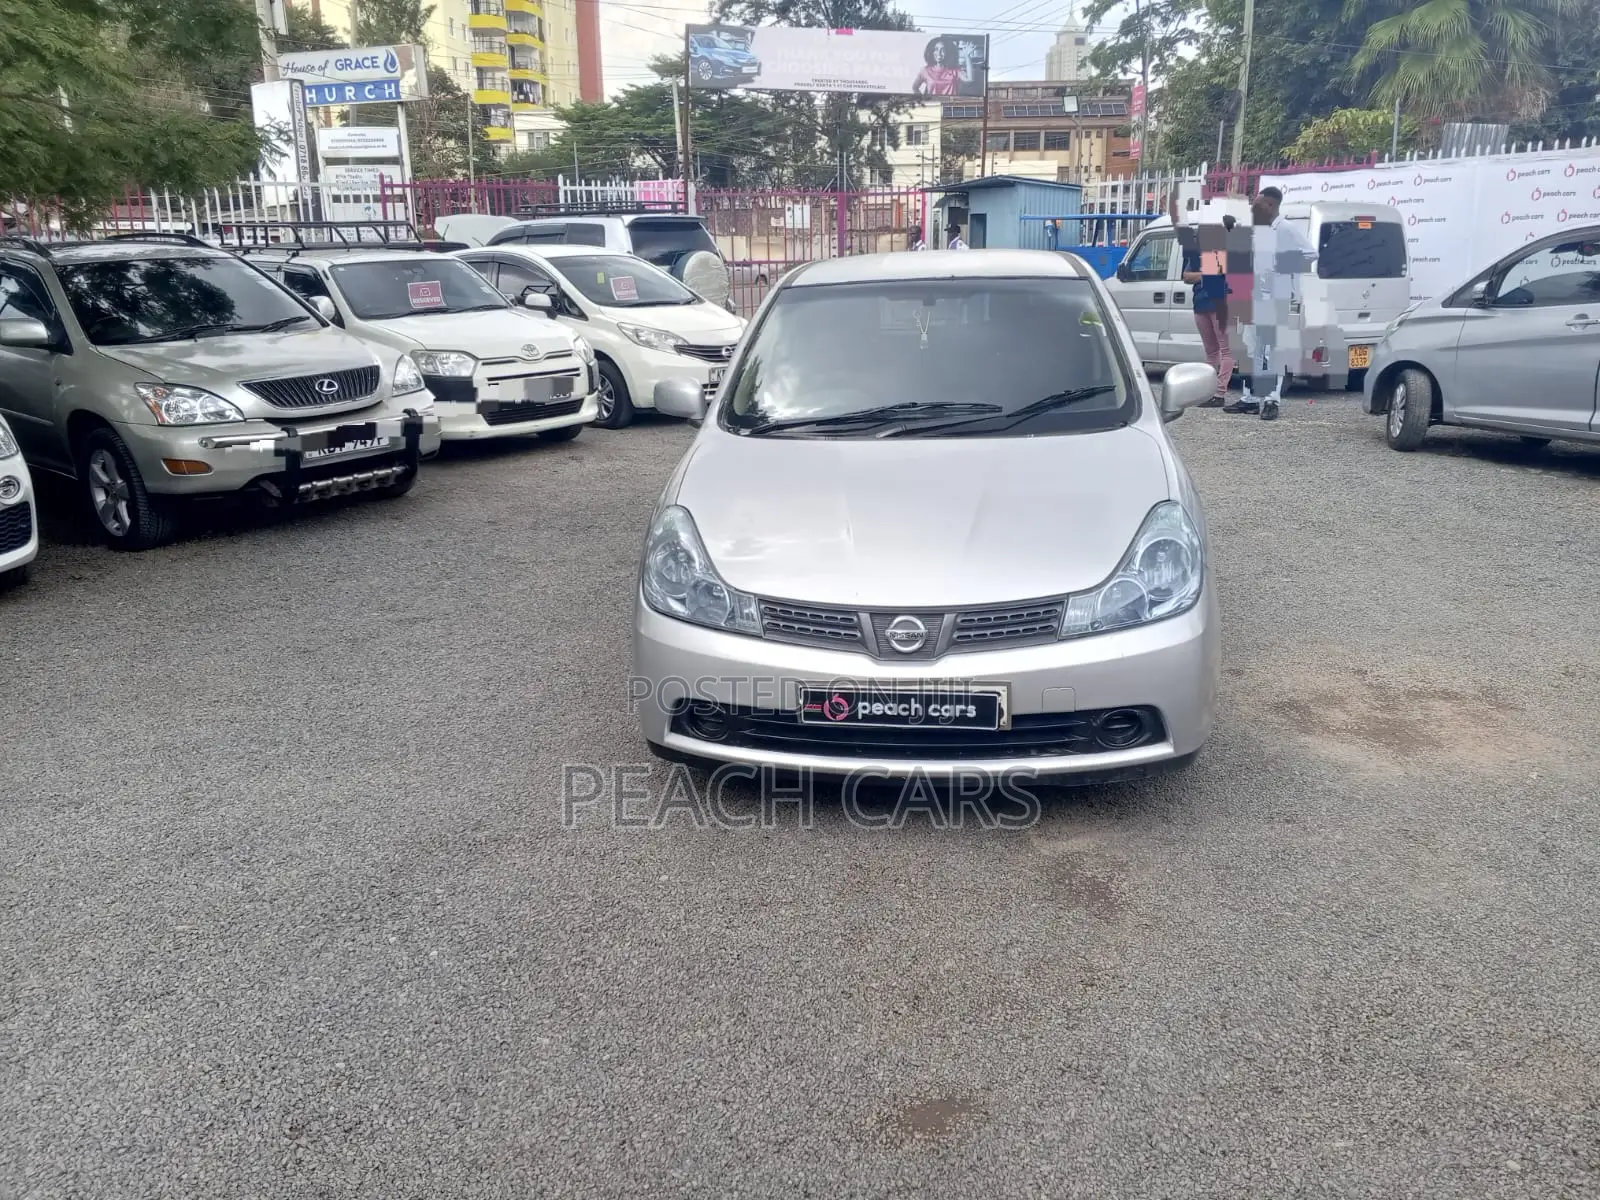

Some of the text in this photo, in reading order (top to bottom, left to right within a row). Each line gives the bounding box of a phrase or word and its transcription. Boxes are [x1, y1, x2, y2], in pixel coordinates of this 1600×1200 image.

[282, 56, 381, 76] House of GRACE
[305, 83, 396, 103] HURCH
[300, 145, 309, 164] 0718
[1517, 169, 1536, 179] peach
[1576, 165, 1596, 175] peach
[1542, 190, 1561, 198] peach
[1568, 211, 1588, 219] peach
[889, 631, 924, 639] NISSAN
[857, 698, 977, 719] peach cars
